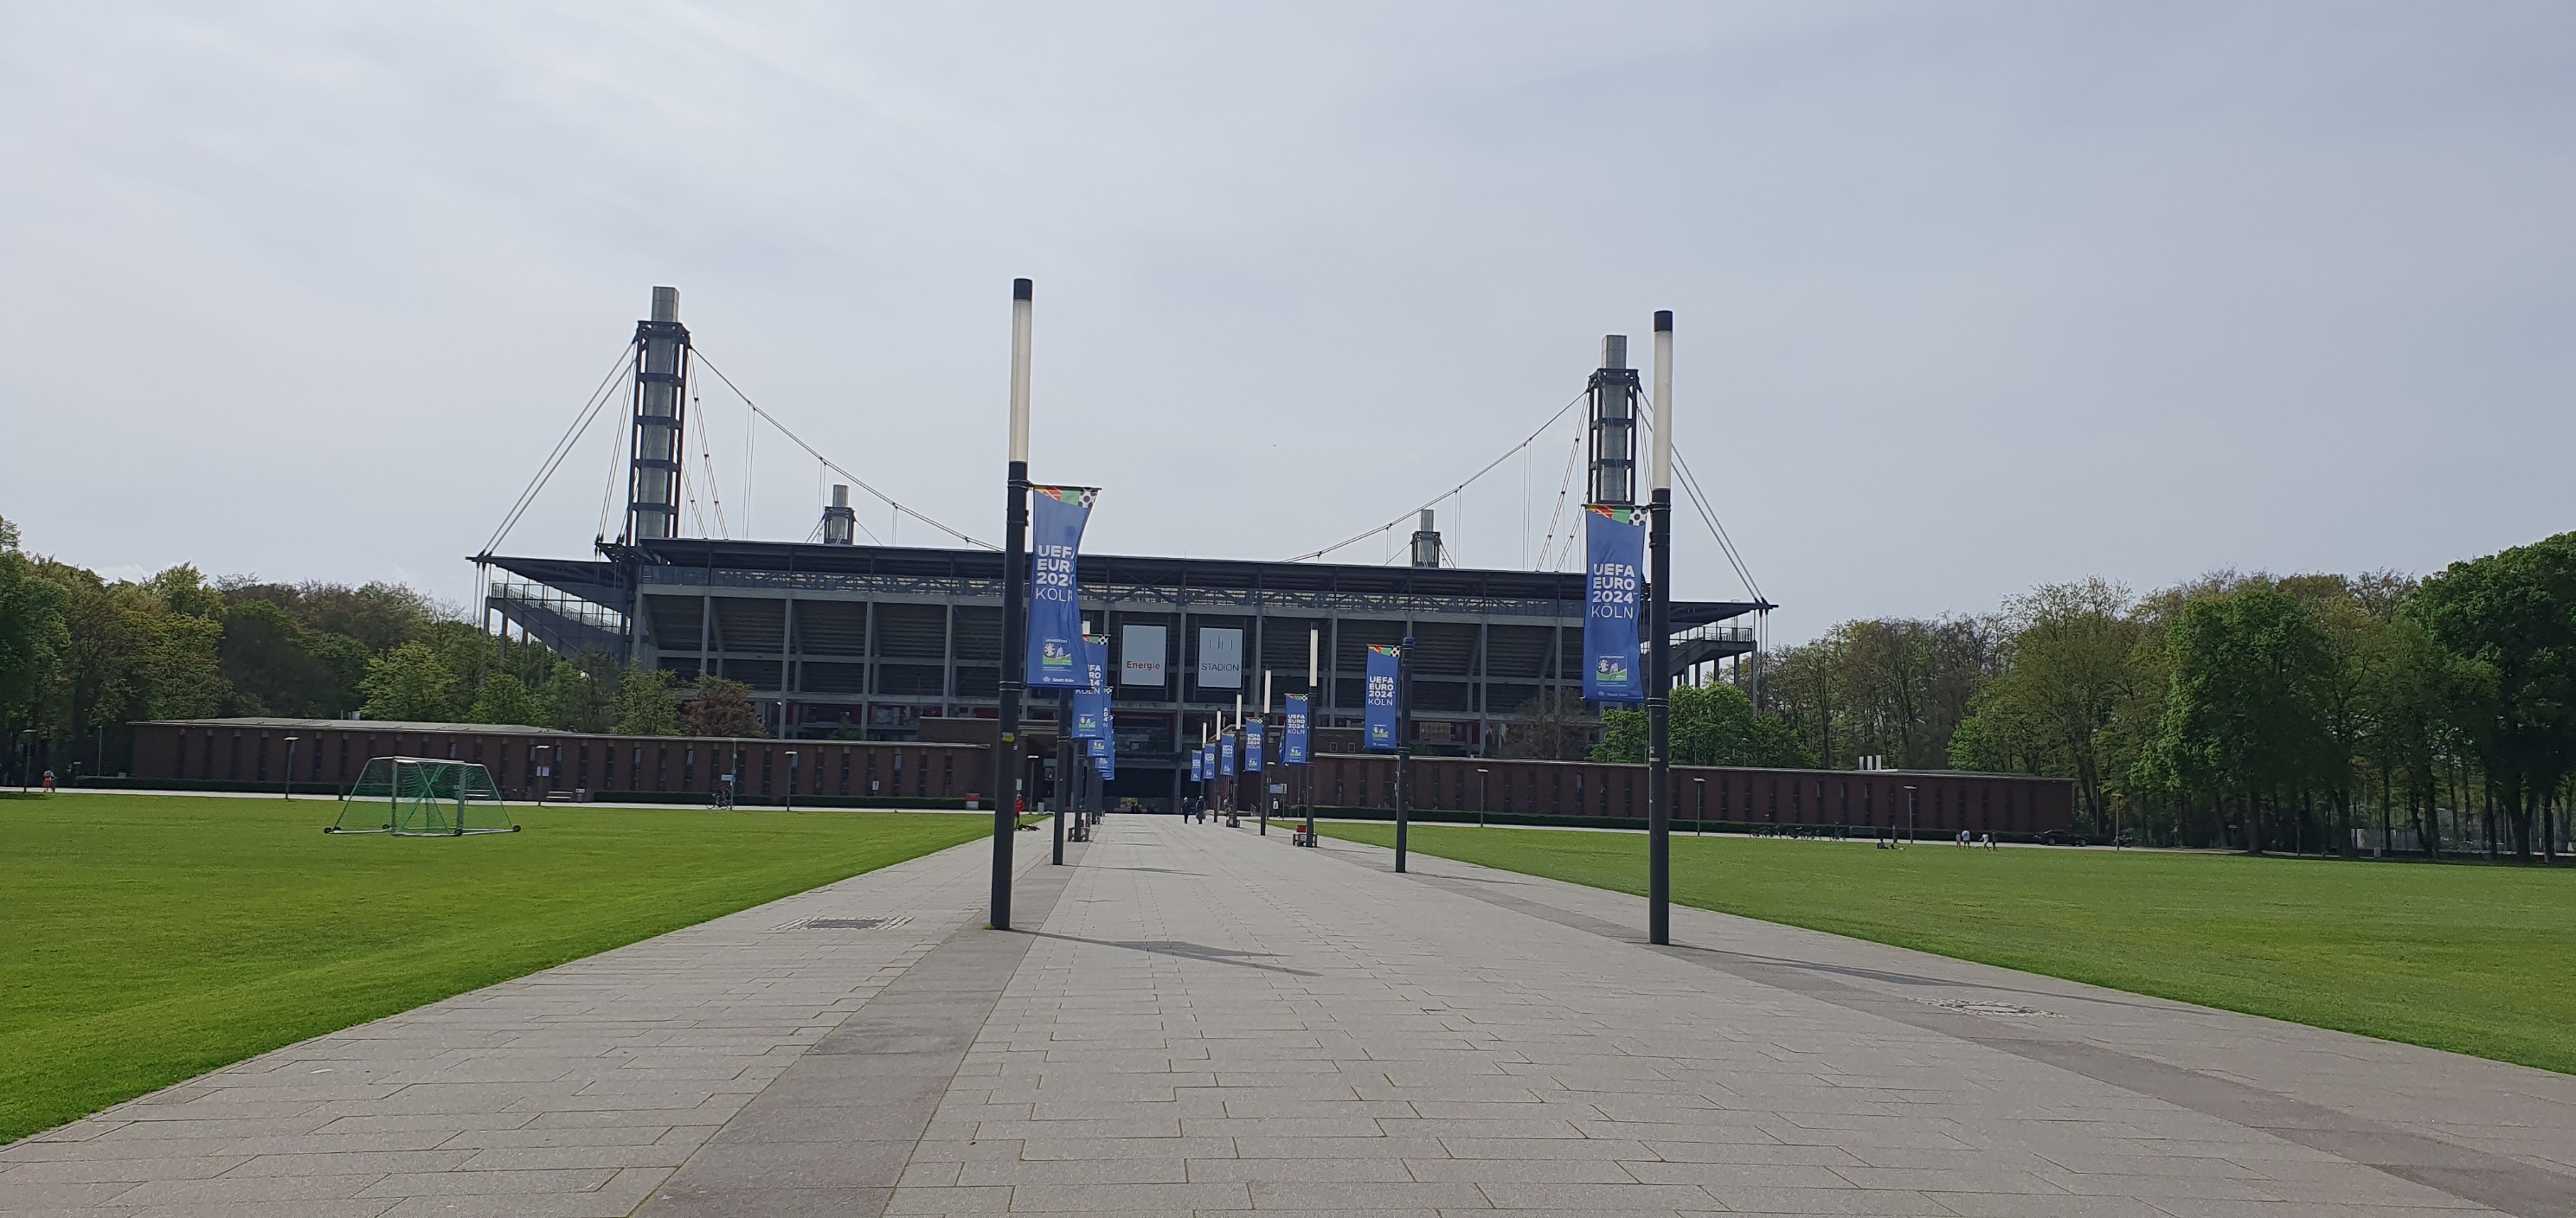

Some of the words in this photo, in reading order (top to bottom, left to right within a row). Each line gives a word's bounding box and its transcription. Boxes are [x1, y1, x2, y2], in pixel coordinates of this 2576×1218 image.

[1593, 563, 1635, 577] UEFA
[1593, 577, 1635, 591] EURO
[1592, 590, 1634, 604] 2024
[1591, 603, 1634, 619] KÖLN
[1127, 660, 1160, 670] Energie
[1201, 663, 1239, 671] STADION
[1369, 676, 1394, 684] UEFA
[1368, 696, 1393, 706] KÖLN
